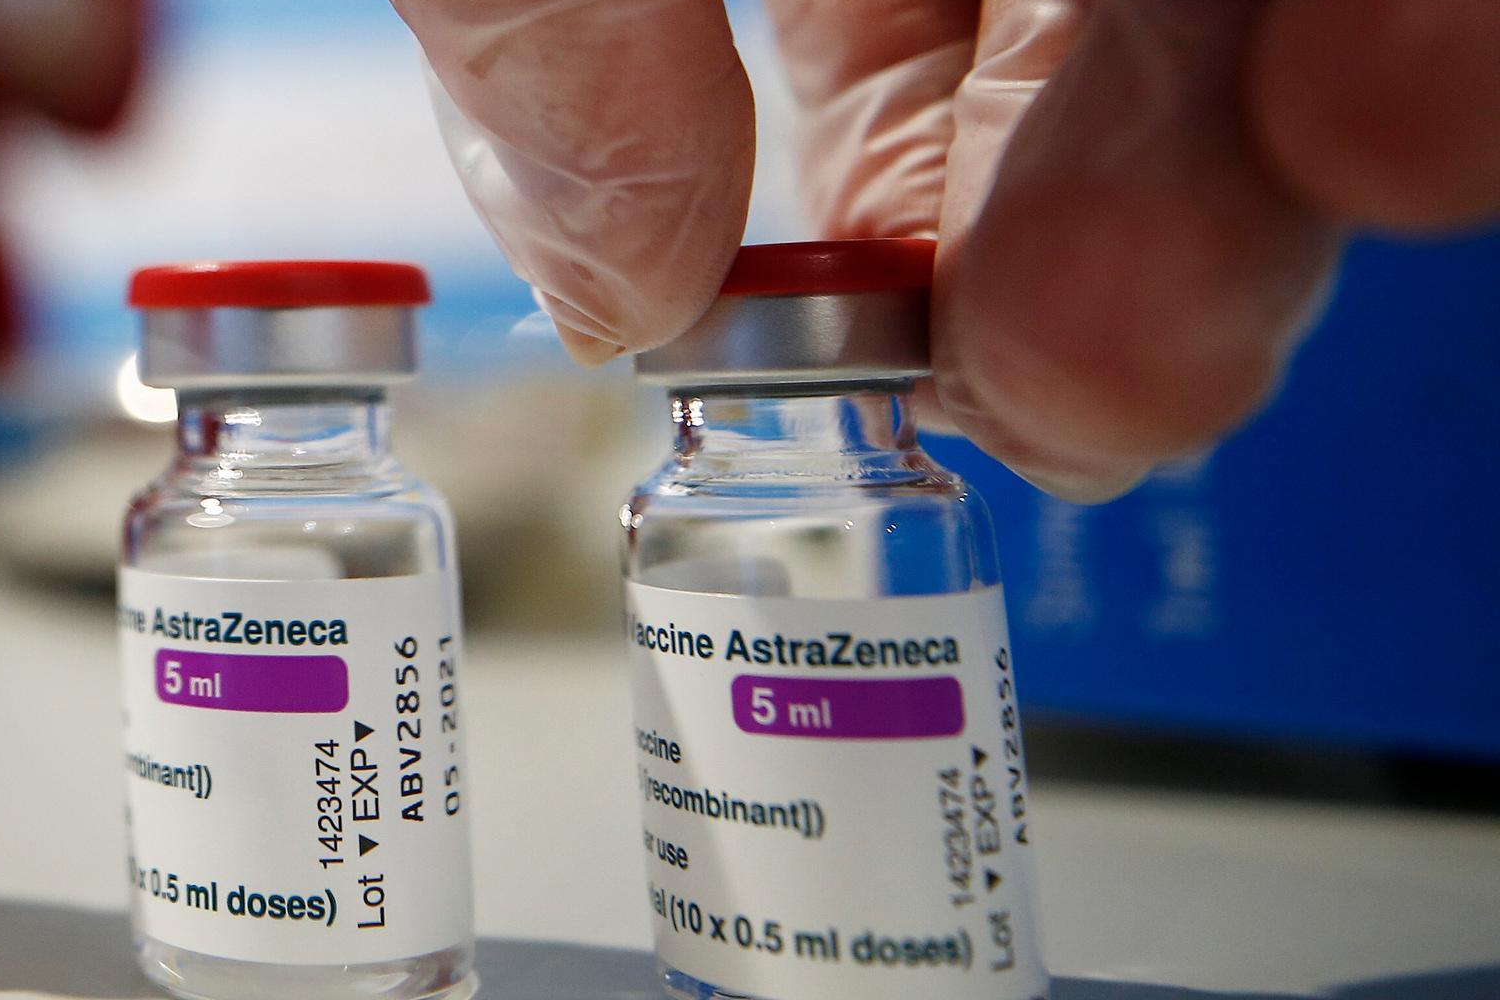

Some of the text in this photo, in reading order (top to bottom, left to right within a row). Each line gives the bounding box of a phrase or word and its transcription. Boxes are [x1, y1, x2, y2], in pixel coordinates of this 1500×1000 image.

[151, 606, 348, 646] AstraZeneca
[725, 629, 960, 668] AstraZeneca
[164, 660, 221, 698] 5 ml
[751, 686, 832, 728] 5 ml
[394, 636, 424, 822] ABV2856
[438, 636, 460, 816] 05-2021
[314, 739, 344, 869] 1423474
[970, 774, 1001, 855] EXP
[350, 748, 386, 929] Lot EXP
[657, 838, 689, 870] use
[151, 868, 179, 903] 0.5
[186, 881, 218, 912] ml
[226, 885, 338, 927] doses)
[670, 894, 702, 935] (10
[708, 913, 728, 942] x
[734, 915, 784, 956] 0.5
[794, 929, 841, 962] ml
[850, 926, 974, 971] doses)
